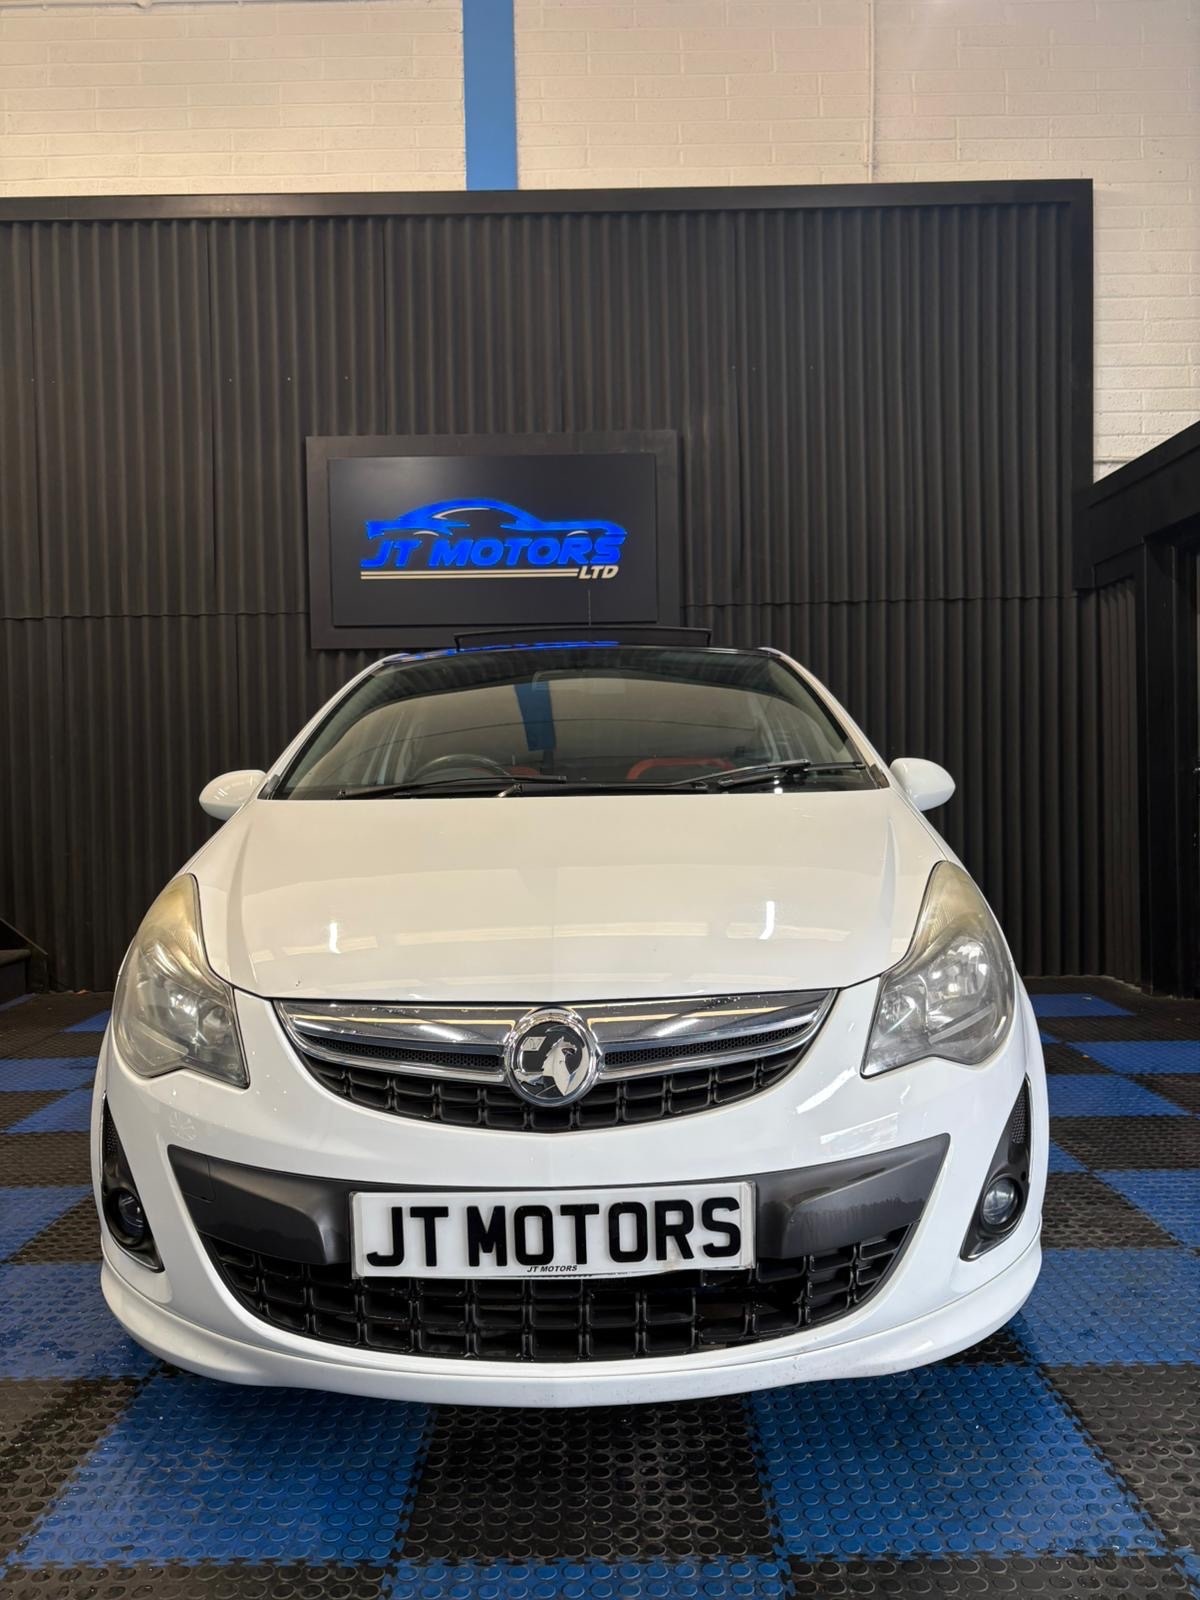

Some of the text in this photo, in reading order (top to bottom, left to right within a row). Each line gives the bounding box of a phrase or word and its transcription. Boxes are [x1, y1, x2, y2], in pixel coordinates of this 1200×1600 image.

[360, 537, 626, 567] JT MOTORS
[578, 565, 619, 580] LTD
[366, 1197, 741, 1267] JT MOTORS
[540, 1265, 578, 1273] MOTORS
